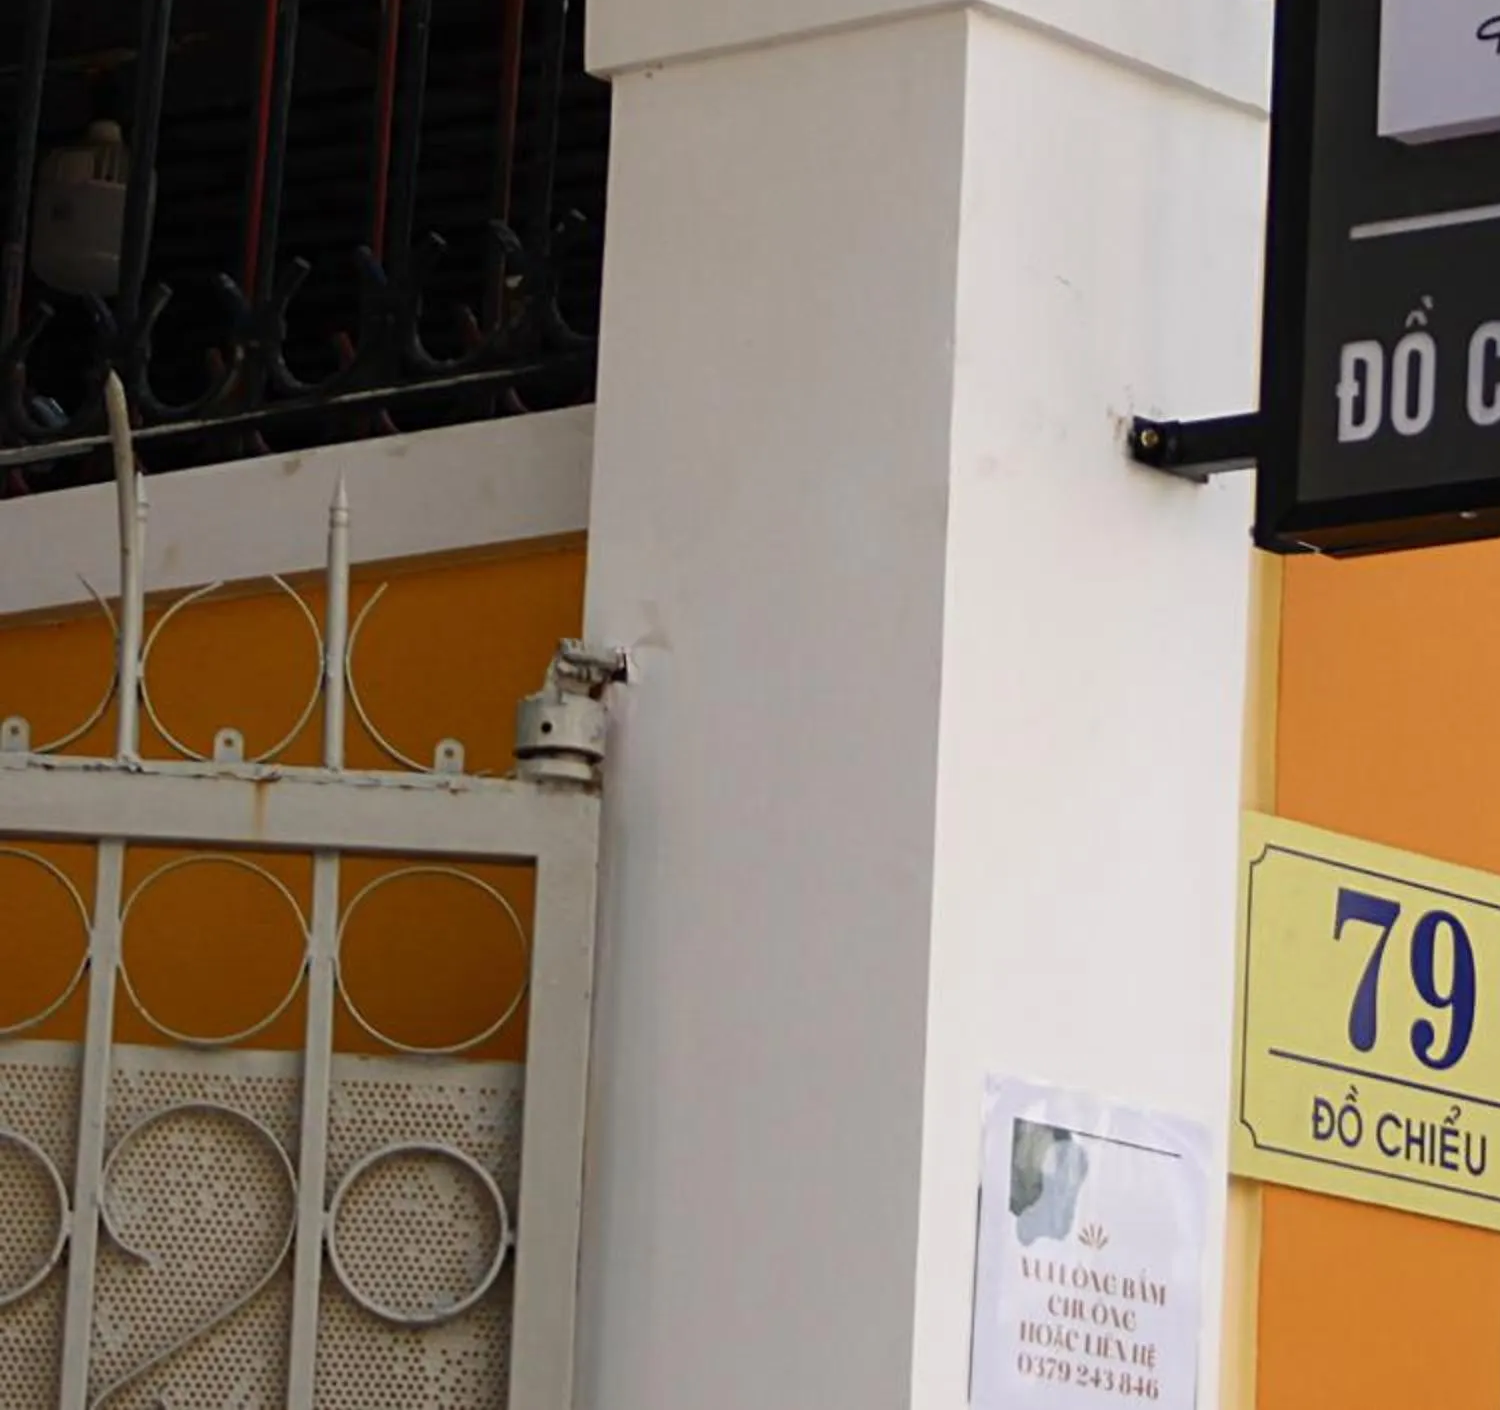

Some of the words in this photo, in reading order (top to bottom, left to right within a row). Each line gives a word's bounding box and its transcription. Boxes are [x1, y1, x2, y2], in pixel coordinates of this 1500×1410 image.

[1336, 295, 1437, 443] ĐỒ
[1333, 887, 1477, 1071] 79
[1312, 1084, 1364, 1148] ĐỒ
[1376, 1105, 1487, 1176] CHIỂU
[1017, 1351, 1071, 1383] 0379
